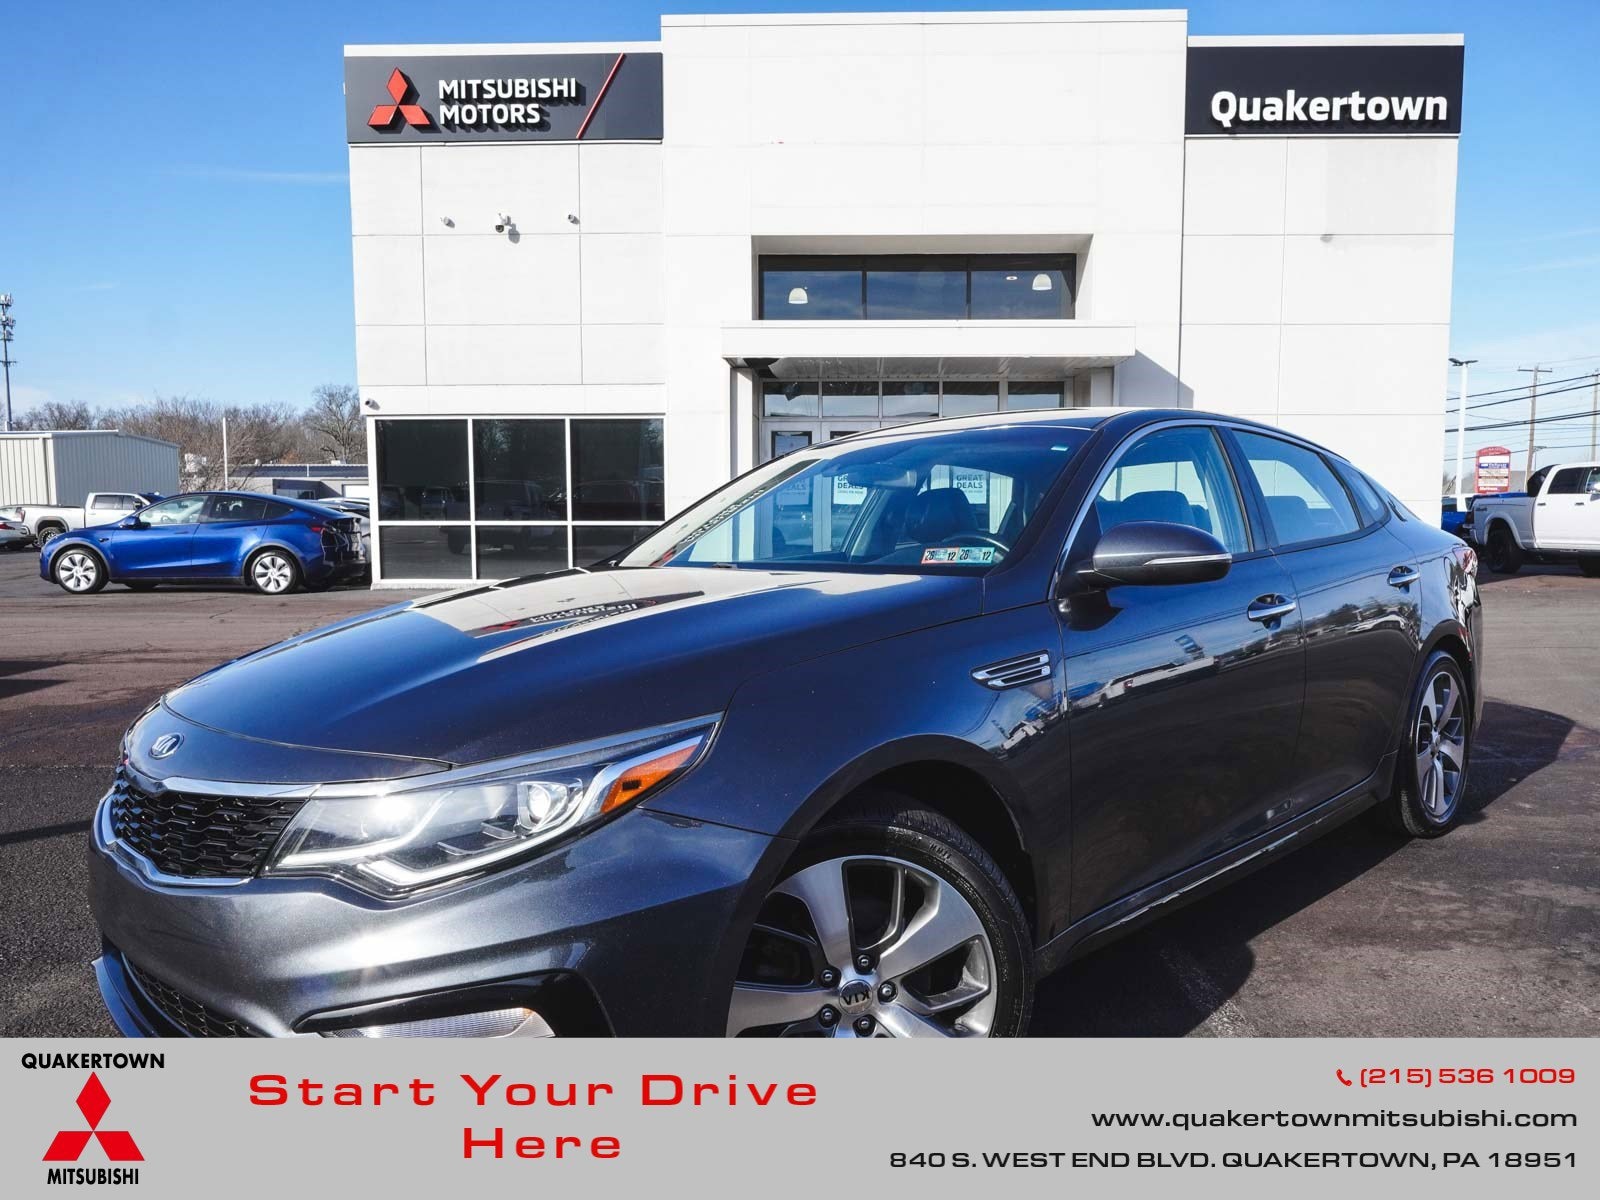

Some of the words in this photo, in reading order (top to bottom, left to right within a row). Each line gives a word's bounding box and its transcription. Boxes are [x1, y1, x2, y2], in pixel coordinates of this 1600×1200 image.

[438, 78, 576, 99] MITSUBISHI
[439, 104, 541, 125] MOTORS
[1211, 89, 1448, 128] Quakertown
[956, 481, 984, 489] DEALS
[946, 552, 956, 561] 12
[981, 552, 991, 561] 12
